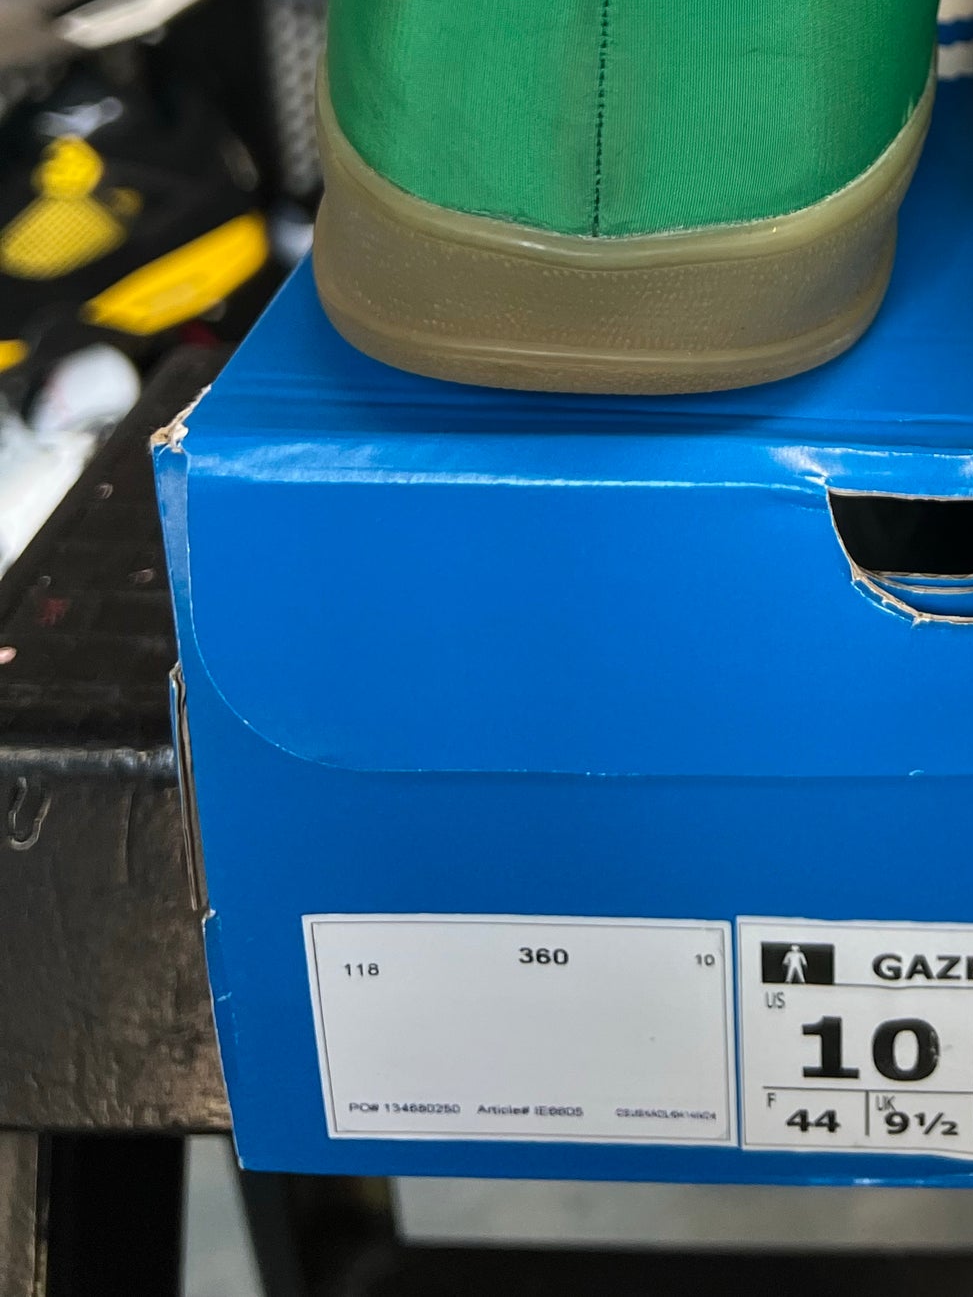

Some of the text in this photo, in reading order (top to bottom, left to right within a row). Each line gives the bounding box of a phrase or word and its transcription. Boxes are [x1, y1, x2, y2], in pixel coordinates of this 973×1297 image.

[519, 948, 570, 966] 360
[696, 954, 715, 966] 10
[344, 963, 380, 976] 118
[765, 992, 785, 1009] US
[802, 1015, 940, 1081] 10
[767, 1093, 777, 1107] F
[876, 1096, 896, 1112] UK
[477, 1105, 529, 1114] Article#
[786, 1109, 840, 1133] 44
